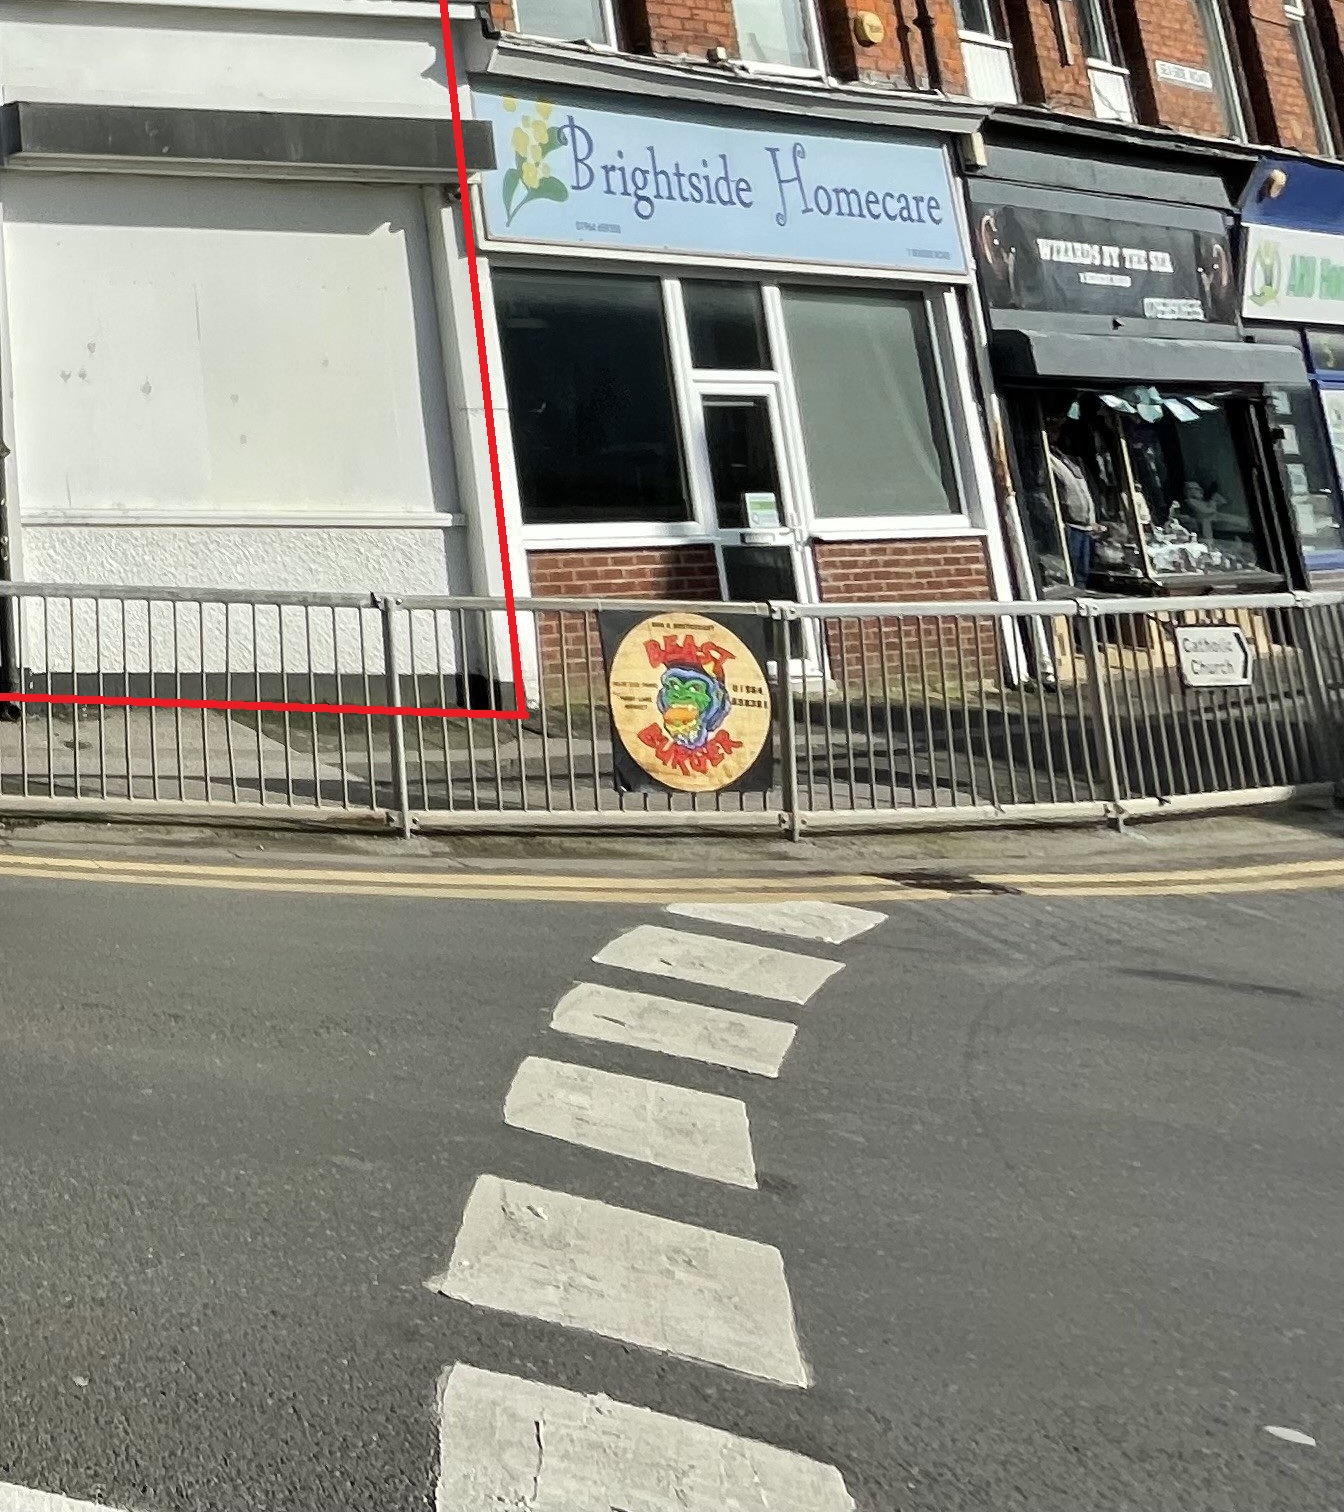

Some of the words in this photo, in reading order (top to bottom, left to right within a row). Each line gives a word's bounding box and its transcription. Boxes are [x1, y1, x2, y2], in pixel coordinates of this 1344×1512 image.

[557, 115, 753, 220] Brightside
[765, 143, 943, 227] Homecare
[643, 634, 736, 685] BEAST
[1182, 637, 1234, 653] Catholic
[1190, 658, 1235, 675] Church
[637, 722, 743, 776] BURGER
